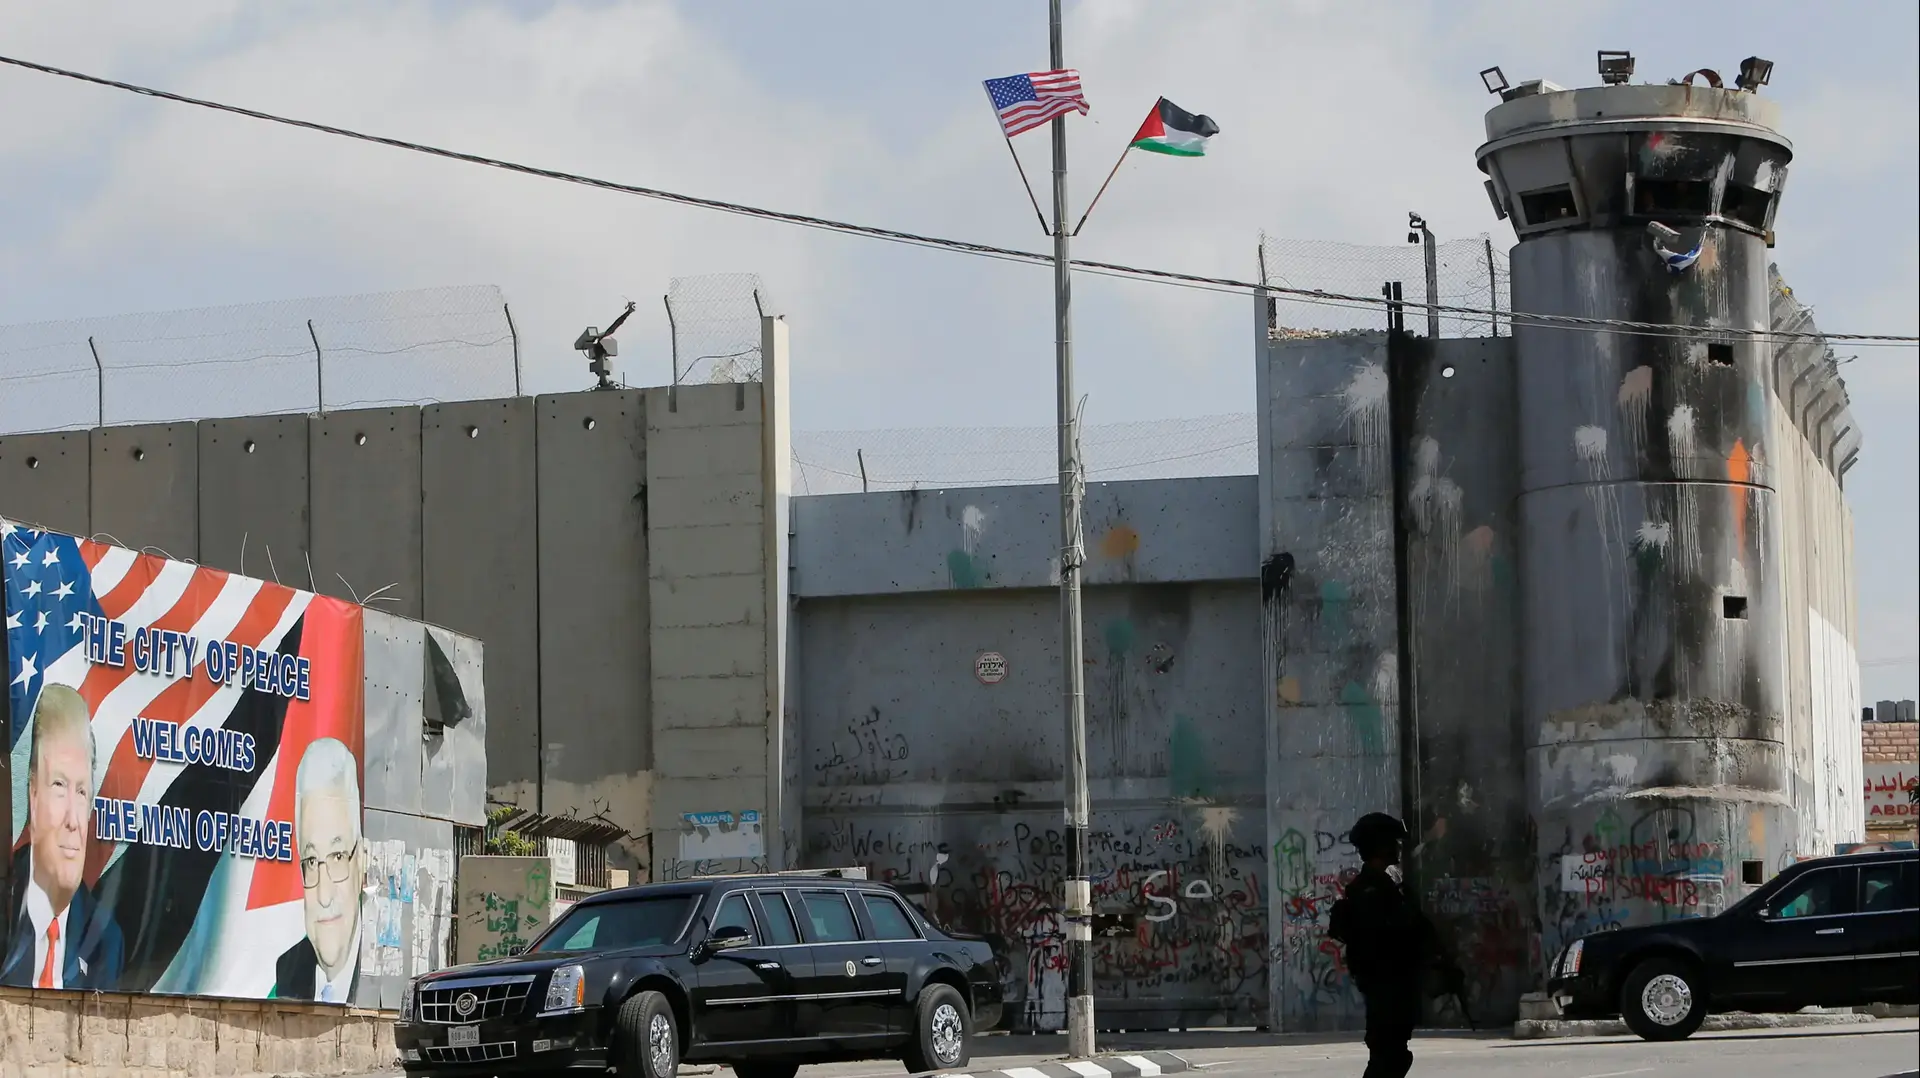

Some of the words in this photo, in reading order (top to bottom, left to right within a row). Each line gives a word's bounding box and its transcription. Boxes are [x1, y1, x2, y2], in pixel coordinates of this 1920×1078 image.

[78, 611, 125, 665] THE
[134, 627, 196, 678] CITY
[206, 640, 239, 686] OF
[241, 648, 311, 701] PEACE
[979, 661, 1004, 669] אילנית
[132, 717, 256, 773] WELCOMES
[94, 796, 138, 843] THE
[141, 800, 192, 850] MAN
[196, 811, 229, 854] OF
[230, 815, 293, 861] PEACE
[700, 813, 756, 824] WARNNG
[850, 822, 952, 857] Welcome
[662, 857, 727, 881] HERE
